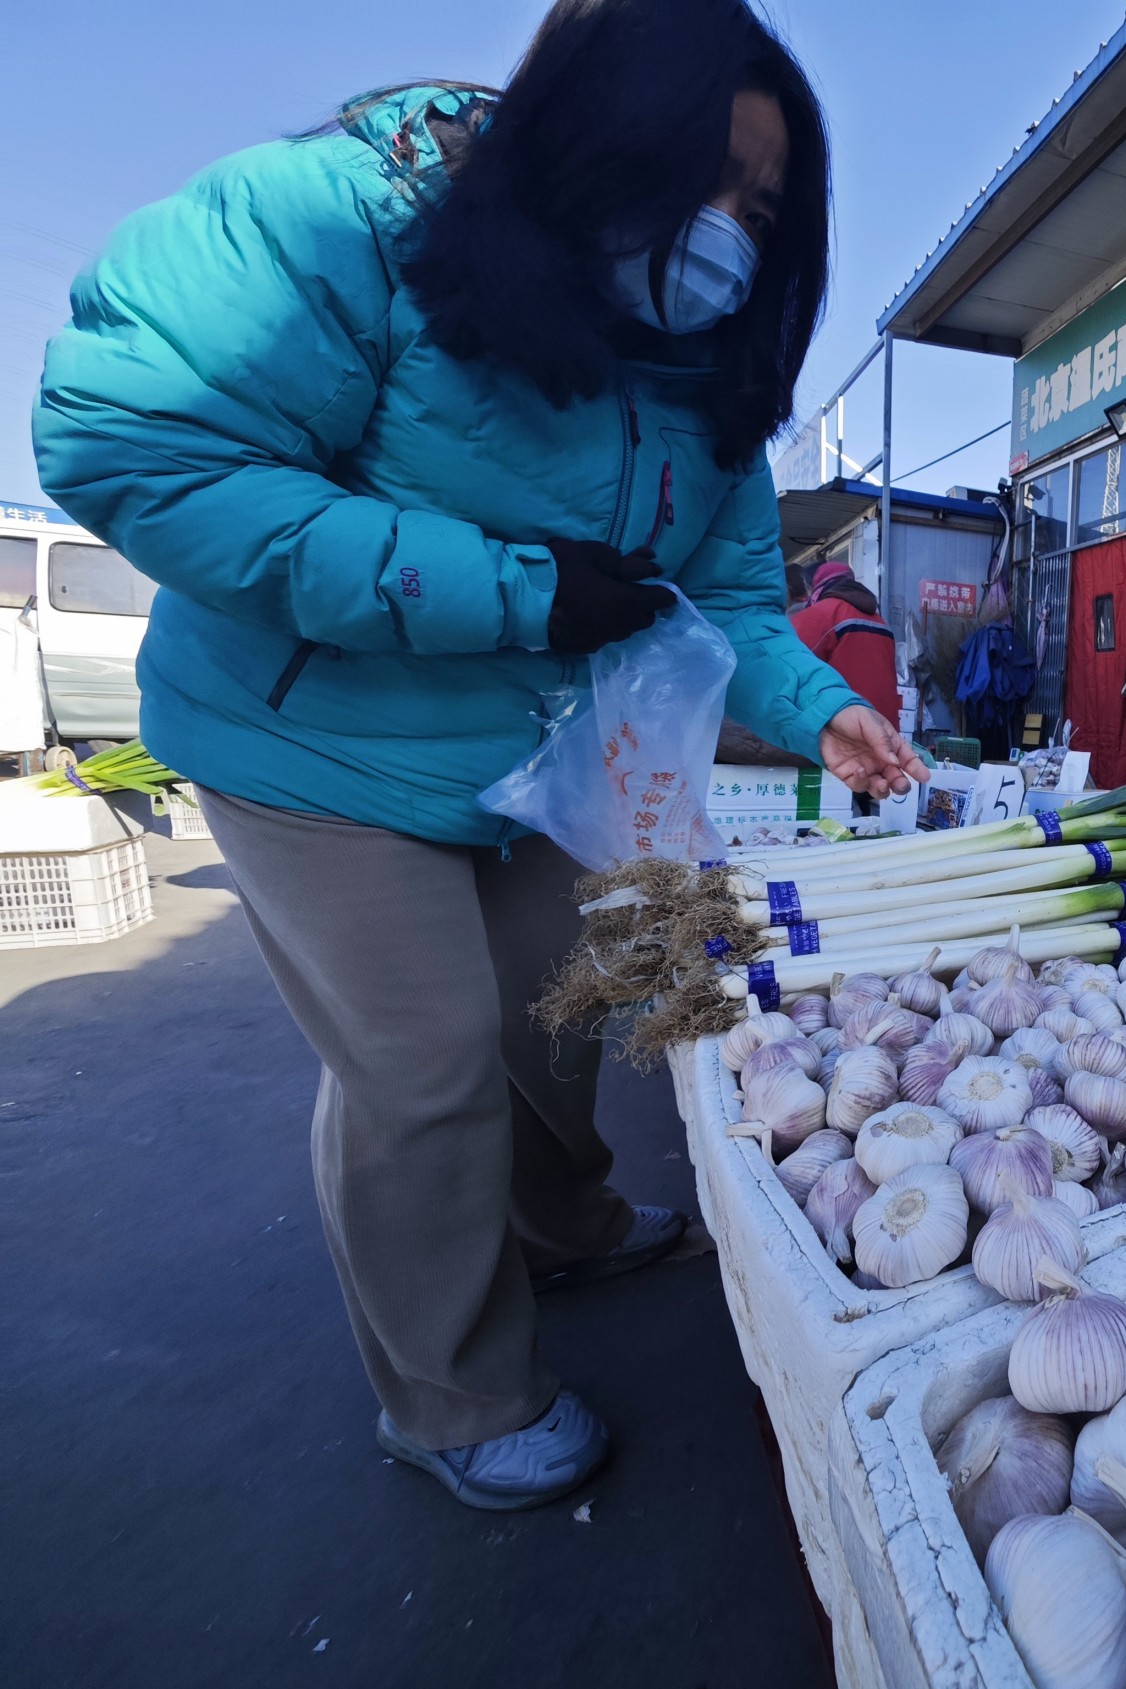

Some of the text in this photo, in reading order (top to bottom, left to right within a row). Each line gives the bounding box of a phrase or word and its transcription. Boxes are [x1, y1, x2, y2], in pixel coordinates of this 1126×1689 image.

[0, 504, 47, 523] 生活
[400, 567, 421, 598] 850
[925, 582, 971, 600] 严禁携带
[994, 775, 1016, 820] 5
